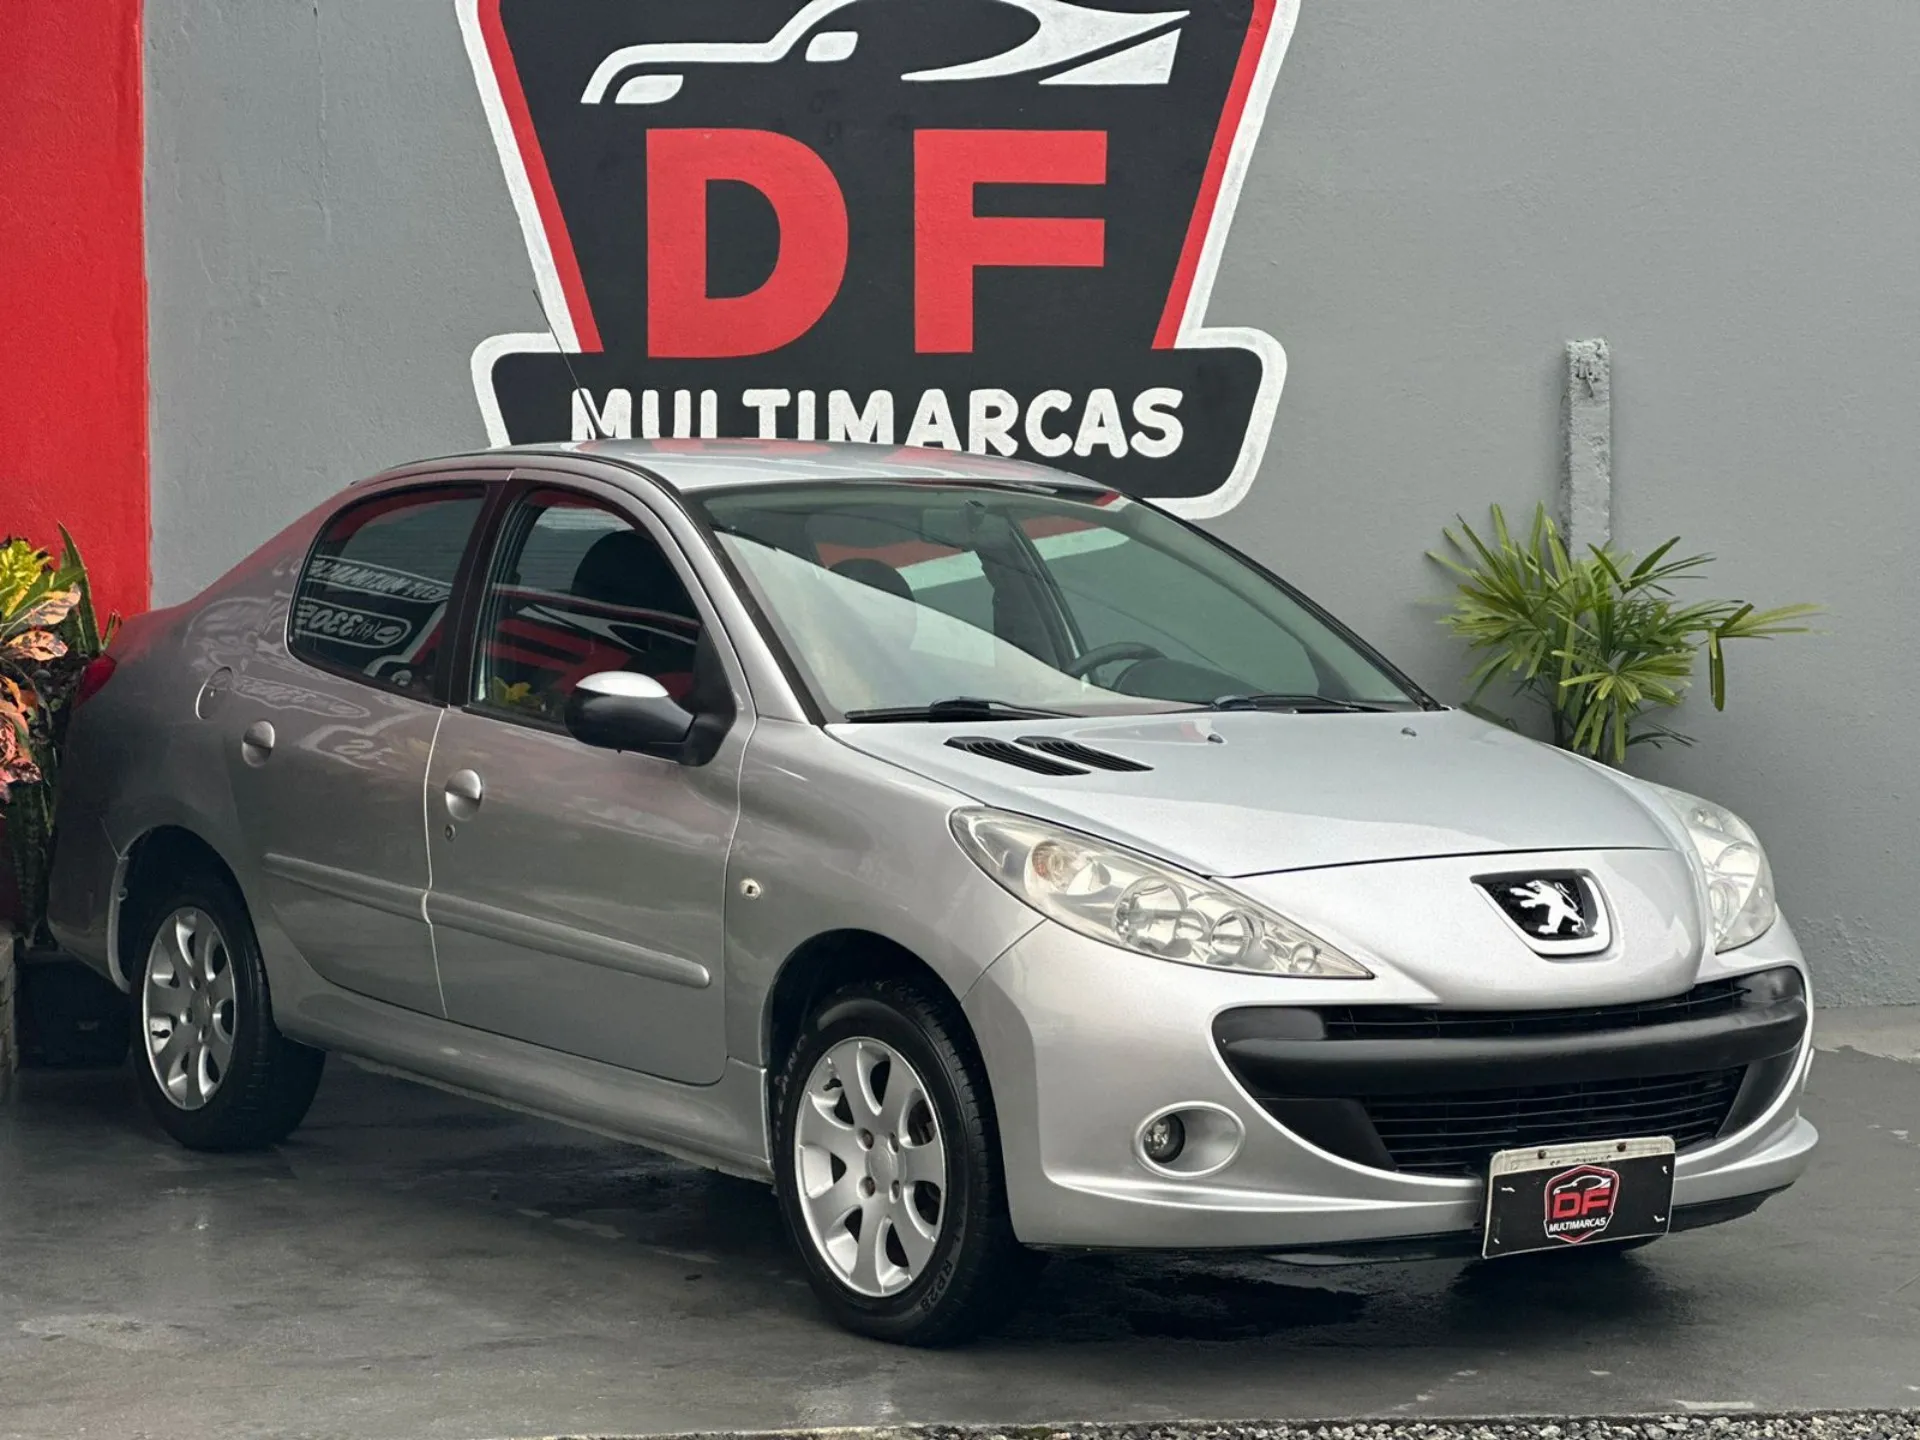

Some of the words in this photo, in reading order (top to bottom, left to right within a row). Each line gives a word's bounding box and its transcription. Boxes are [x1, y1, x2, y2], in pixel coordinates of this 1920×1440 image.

[646, 127, 1108, 359] DF
[1552, 1187, 1611, 1219] DF
[1548, 1216, 1607, 1232] MULTIMARCAS
